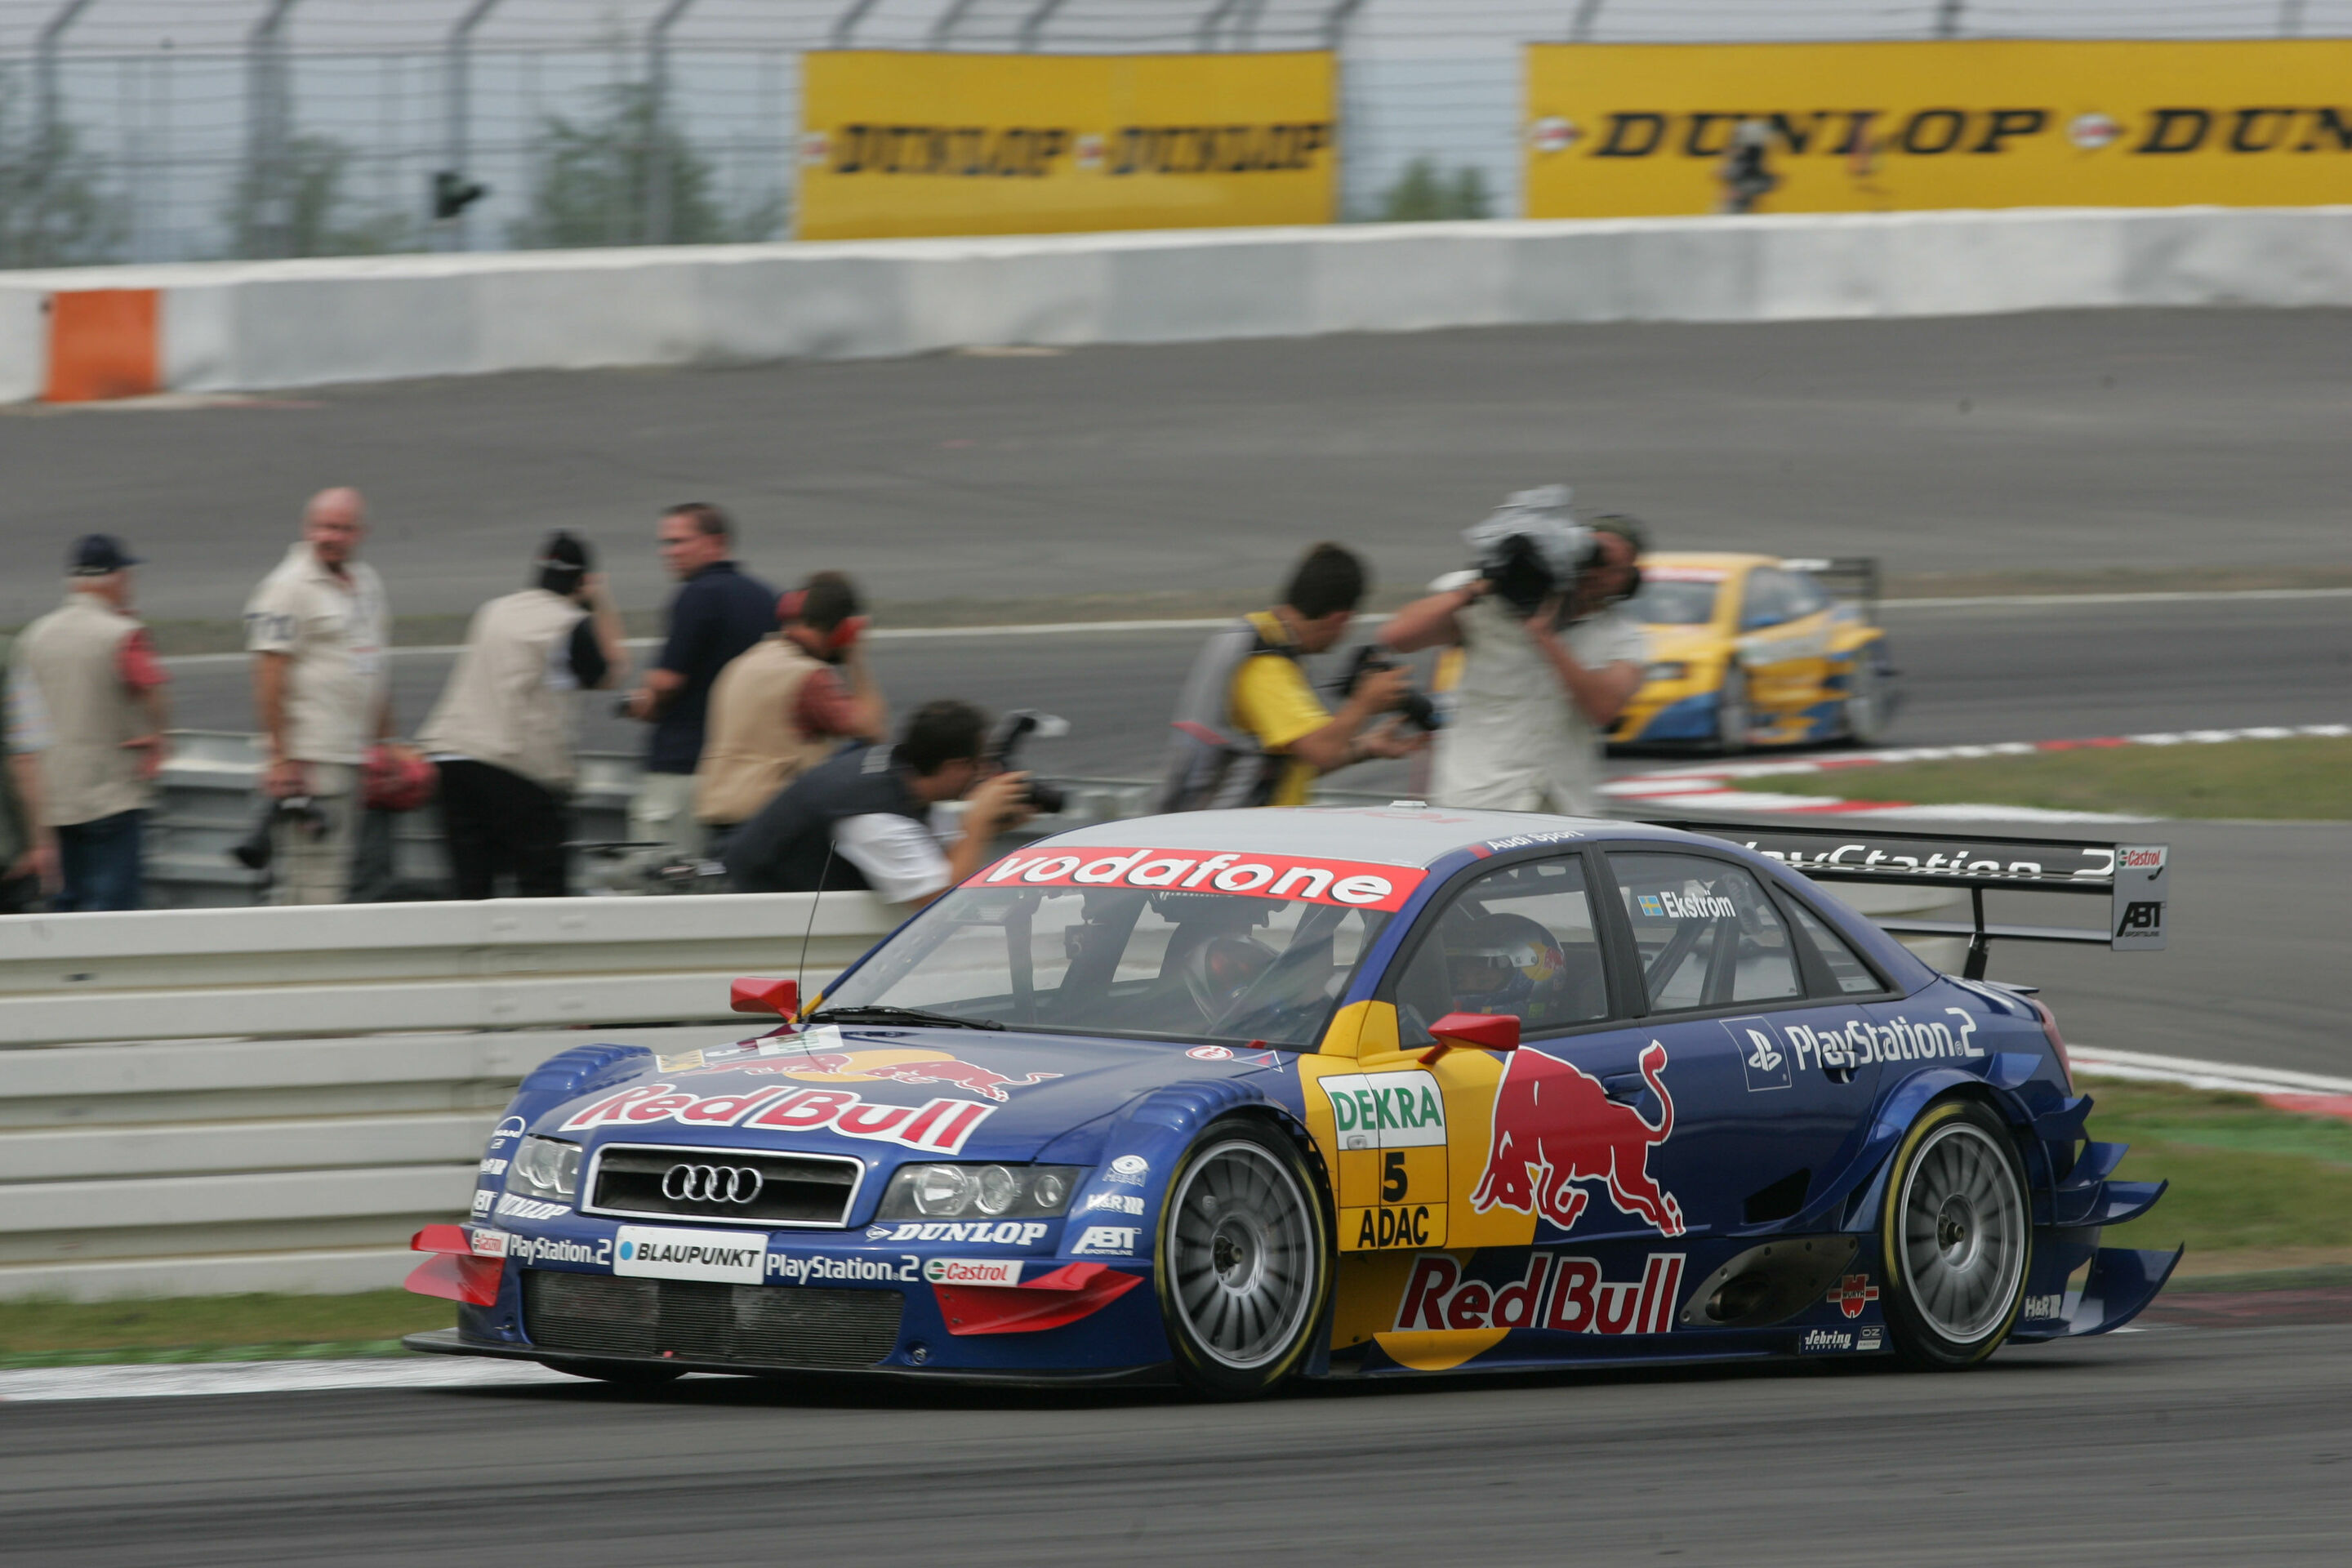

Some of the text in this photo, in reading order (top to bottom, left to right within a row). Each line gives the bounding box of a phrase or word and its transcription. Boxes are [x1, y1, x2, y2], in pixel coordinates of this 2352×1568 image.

[1486, 830, 1584, 851] Audi Sport
[2127, 849, 2161, 866] Castrol
[986, 849, 1393, 904] vodafone
[1659, 889, 1737, 919] Ekström
[2116, 901, 2163, 938] ABT
[1784, 1006, 1985, 1084] PlayStation 2
[559, 1083, 999, 1156] Red Bull
[1330, 1085, 1443, 1132] DEKRA
[1382, 1152, 1409, 1203] 5
[887, 1222, 1049, 1246] DUNLOP
[1071, 1226, 1137, 1254] ABT
[1357, 1205, 1429, 1249] ADAC
[510, 1234, 612, 1266] PlayStation 2
[636, 1243, 761, 1267] BLAUPUNKT
[766, 1253, 920, 1285] PlayStation 2
[946, 1262, 1009, 1281] Castrol
[1391, 1251, 1687, 1334] Red Bull
[1804, 1329, 1852, 1350] Sebring
[1862, 1328, 1881, 1337] OZ
